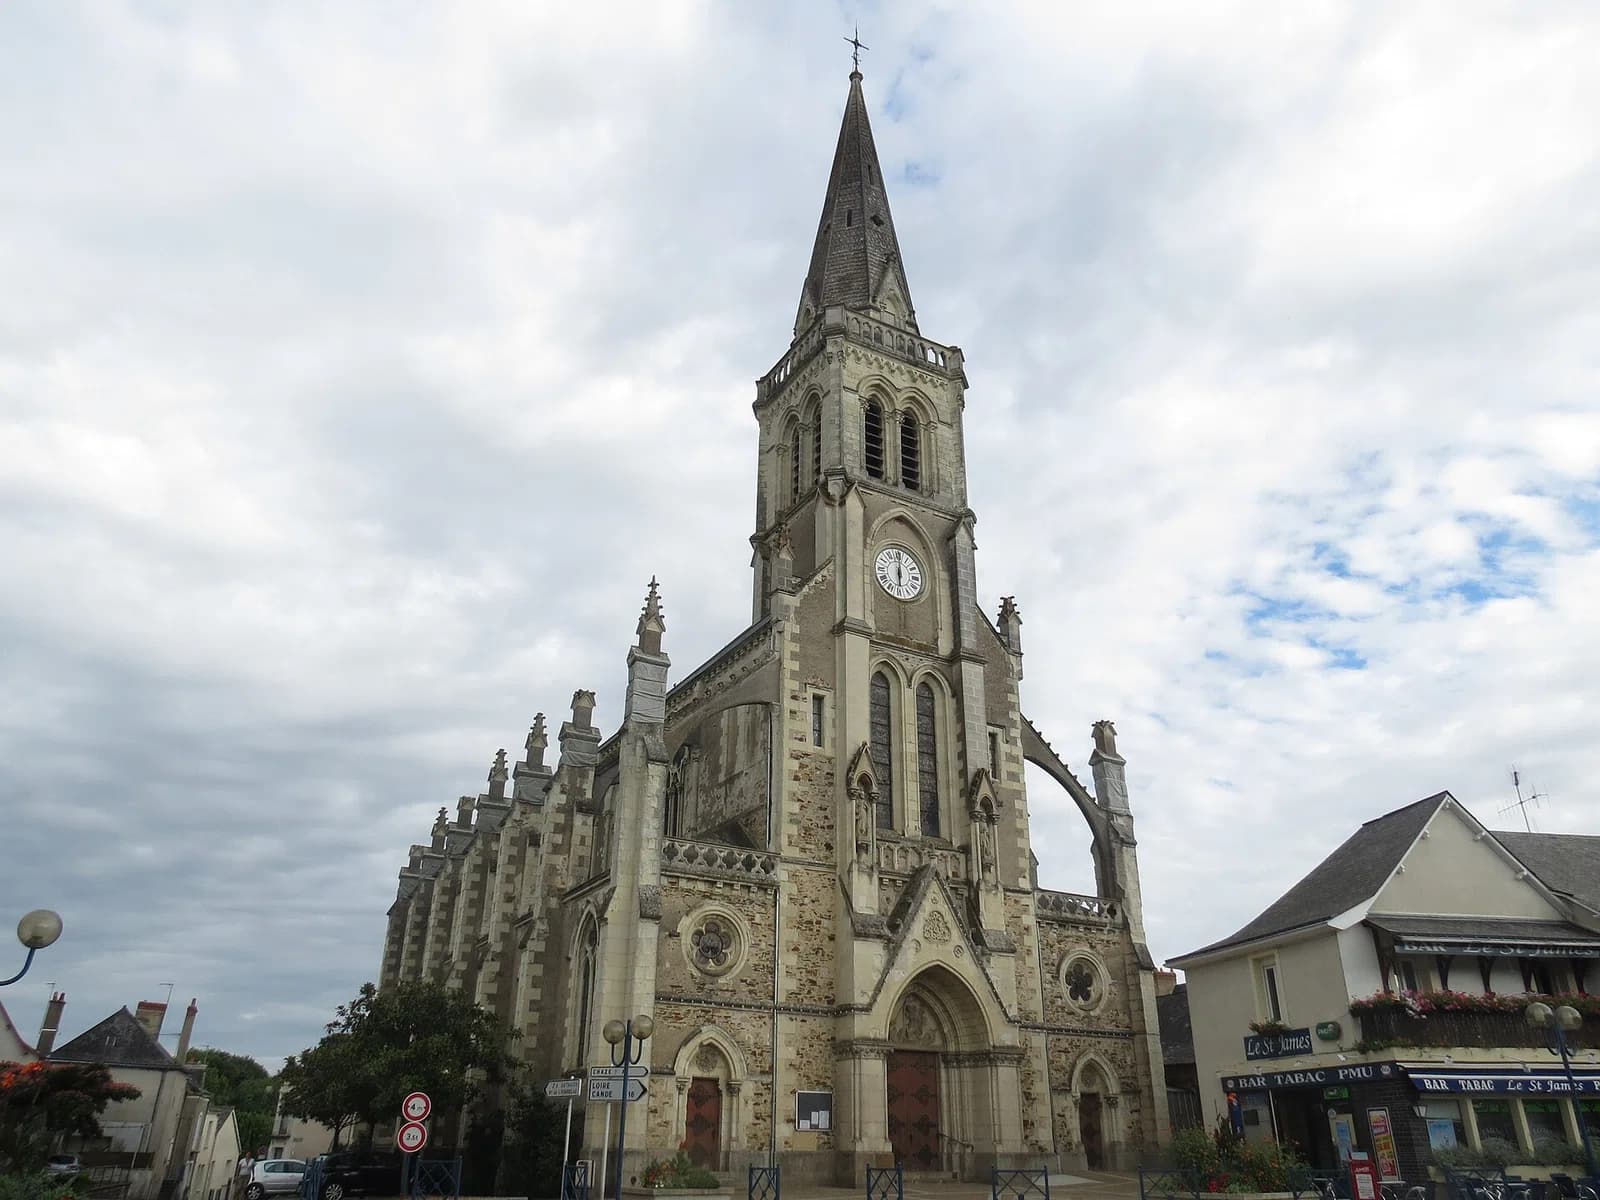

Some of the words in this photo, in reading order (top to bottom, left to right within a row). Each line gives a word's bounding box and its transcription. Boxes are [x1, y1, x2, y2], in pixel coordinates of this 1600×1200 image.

[1247, 1038, 1261, 1056] Le
[1262, 1036, 1274, 1055] St
[1278, 1034, 1311, 1055] James
[1239, 1076, 1266, 1088] BAR
[1273, 1071, 1326, 1085] TABAC
[1338, 1066, 1373, 1080] PMU
[1423, 1079, 1449, 1090] BAR
[1458, 1079, 1495, 1090] TABAC
[1506, 1079, 1522, 1090] Le
[1528, 1079, 1542, 1092] St
